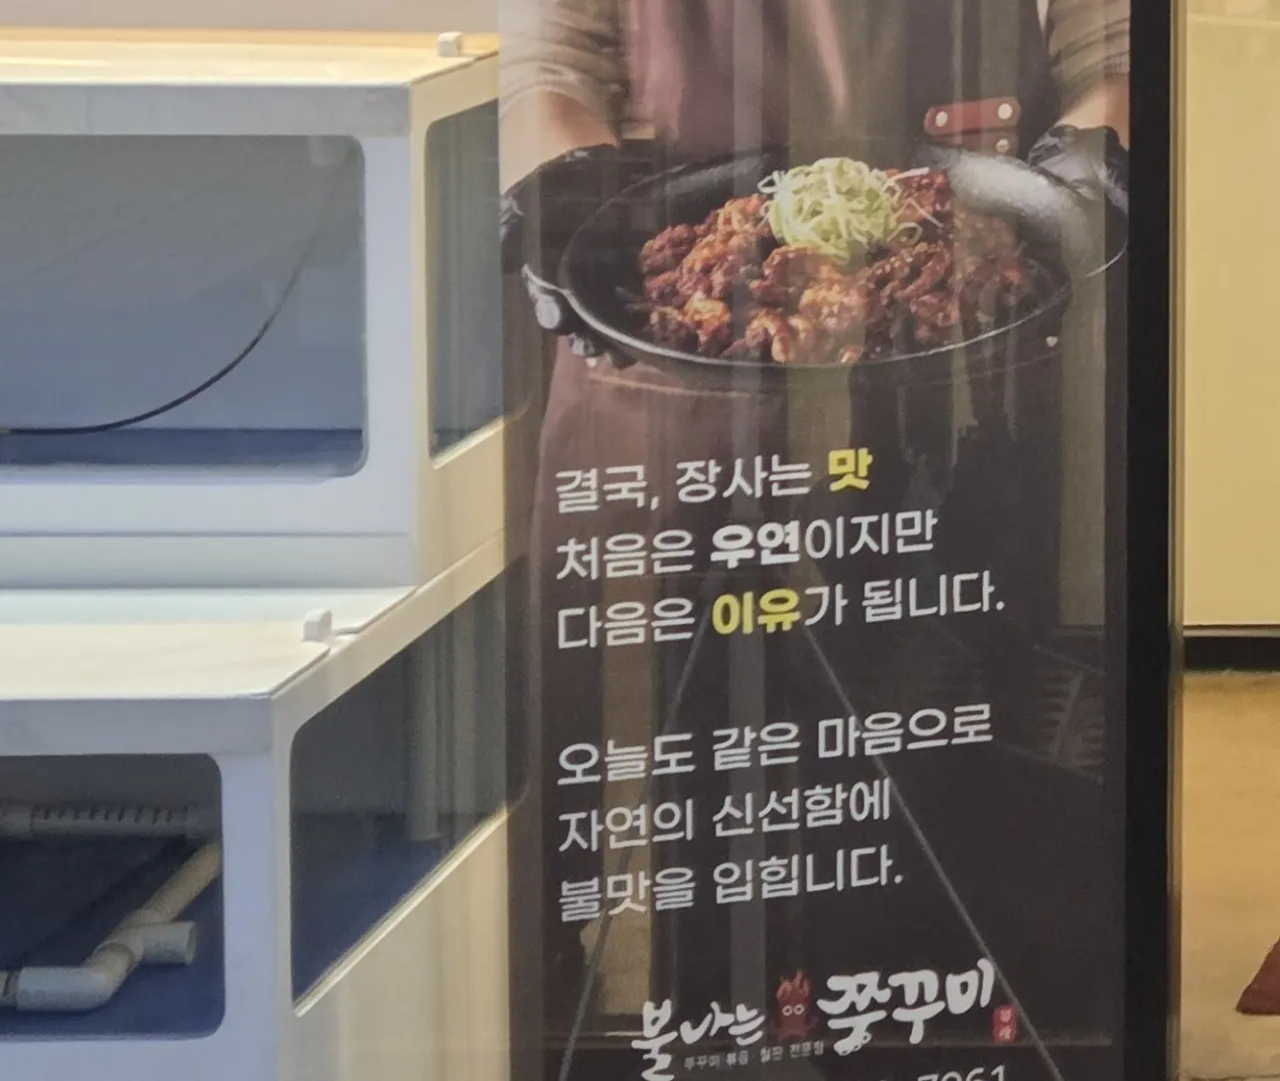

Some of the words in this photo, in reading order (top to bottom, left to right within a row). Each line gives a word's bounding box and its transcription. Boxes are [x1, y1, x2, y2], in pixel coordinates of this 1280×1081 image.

[556, 467, 661, 514] 결국,
[675, 455, 812, 503] 장사는
[828, 448, 873, 491] 맛
[556, 531, 695, 581] 처음은
[710, 510, 938, 569] 우연이지만
[556, 597, 695, 649] 다음은
[712, 584, 847, 636] 이유가
[861, 571, 1005, 623] 됩니다.
[556, 734, 695, 786] 오늘도
[712, 721, 800, 772] 같은
[818, 704, 993, 759] 마음으로
[558, 800, 695, 853] 자연의
[712, 778, 891, 838] 신선함에
[558, 866, 695, 922] 불맛을
[712, 845, 903, 904] 입힙니다.
[631, 998, 765, 1081] 불나는
